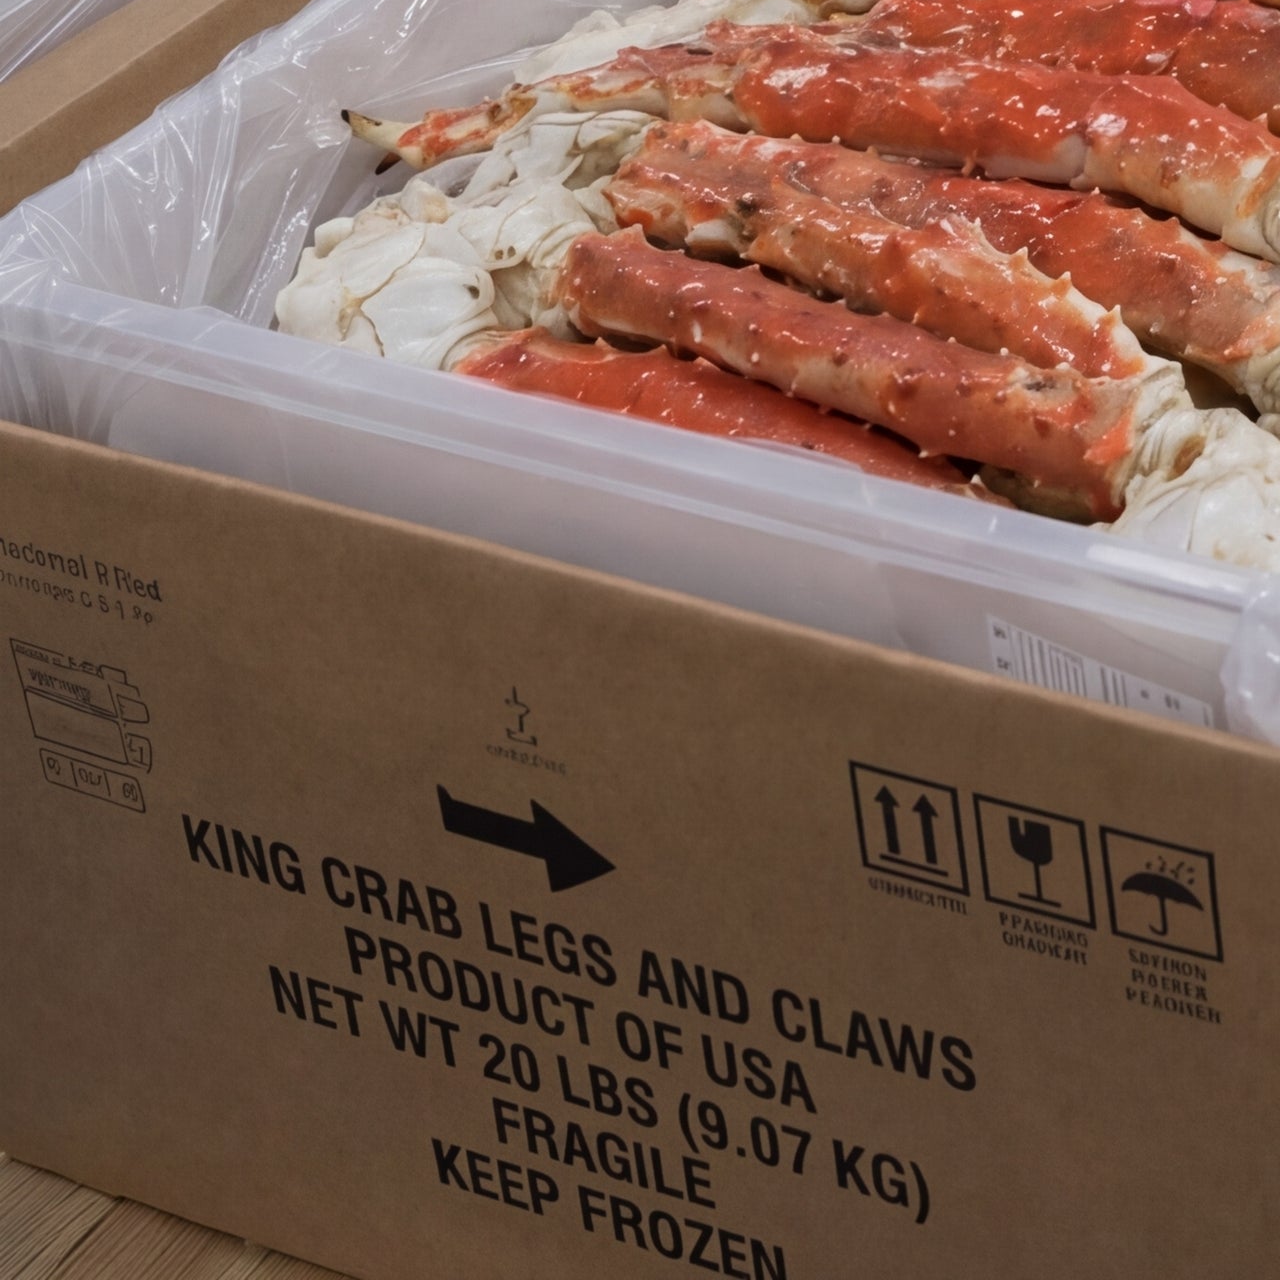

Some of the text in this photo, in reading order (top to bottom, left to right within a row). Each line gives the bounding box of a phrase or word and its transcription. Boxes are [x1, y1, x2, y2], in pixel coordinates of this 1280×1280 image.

[181, 812, 977, 1092] KING CRAB LEGS AND CLAWS
[343, 925, 818, 1115] PRODUCT OF USA
[268, 964, 931, 1225] NET WT 20 LBS (9.07 KG)
[492, 1096, 716, 1210] FRAGILE
[431, 1137, 788, 1280] KEEP FROZEN
